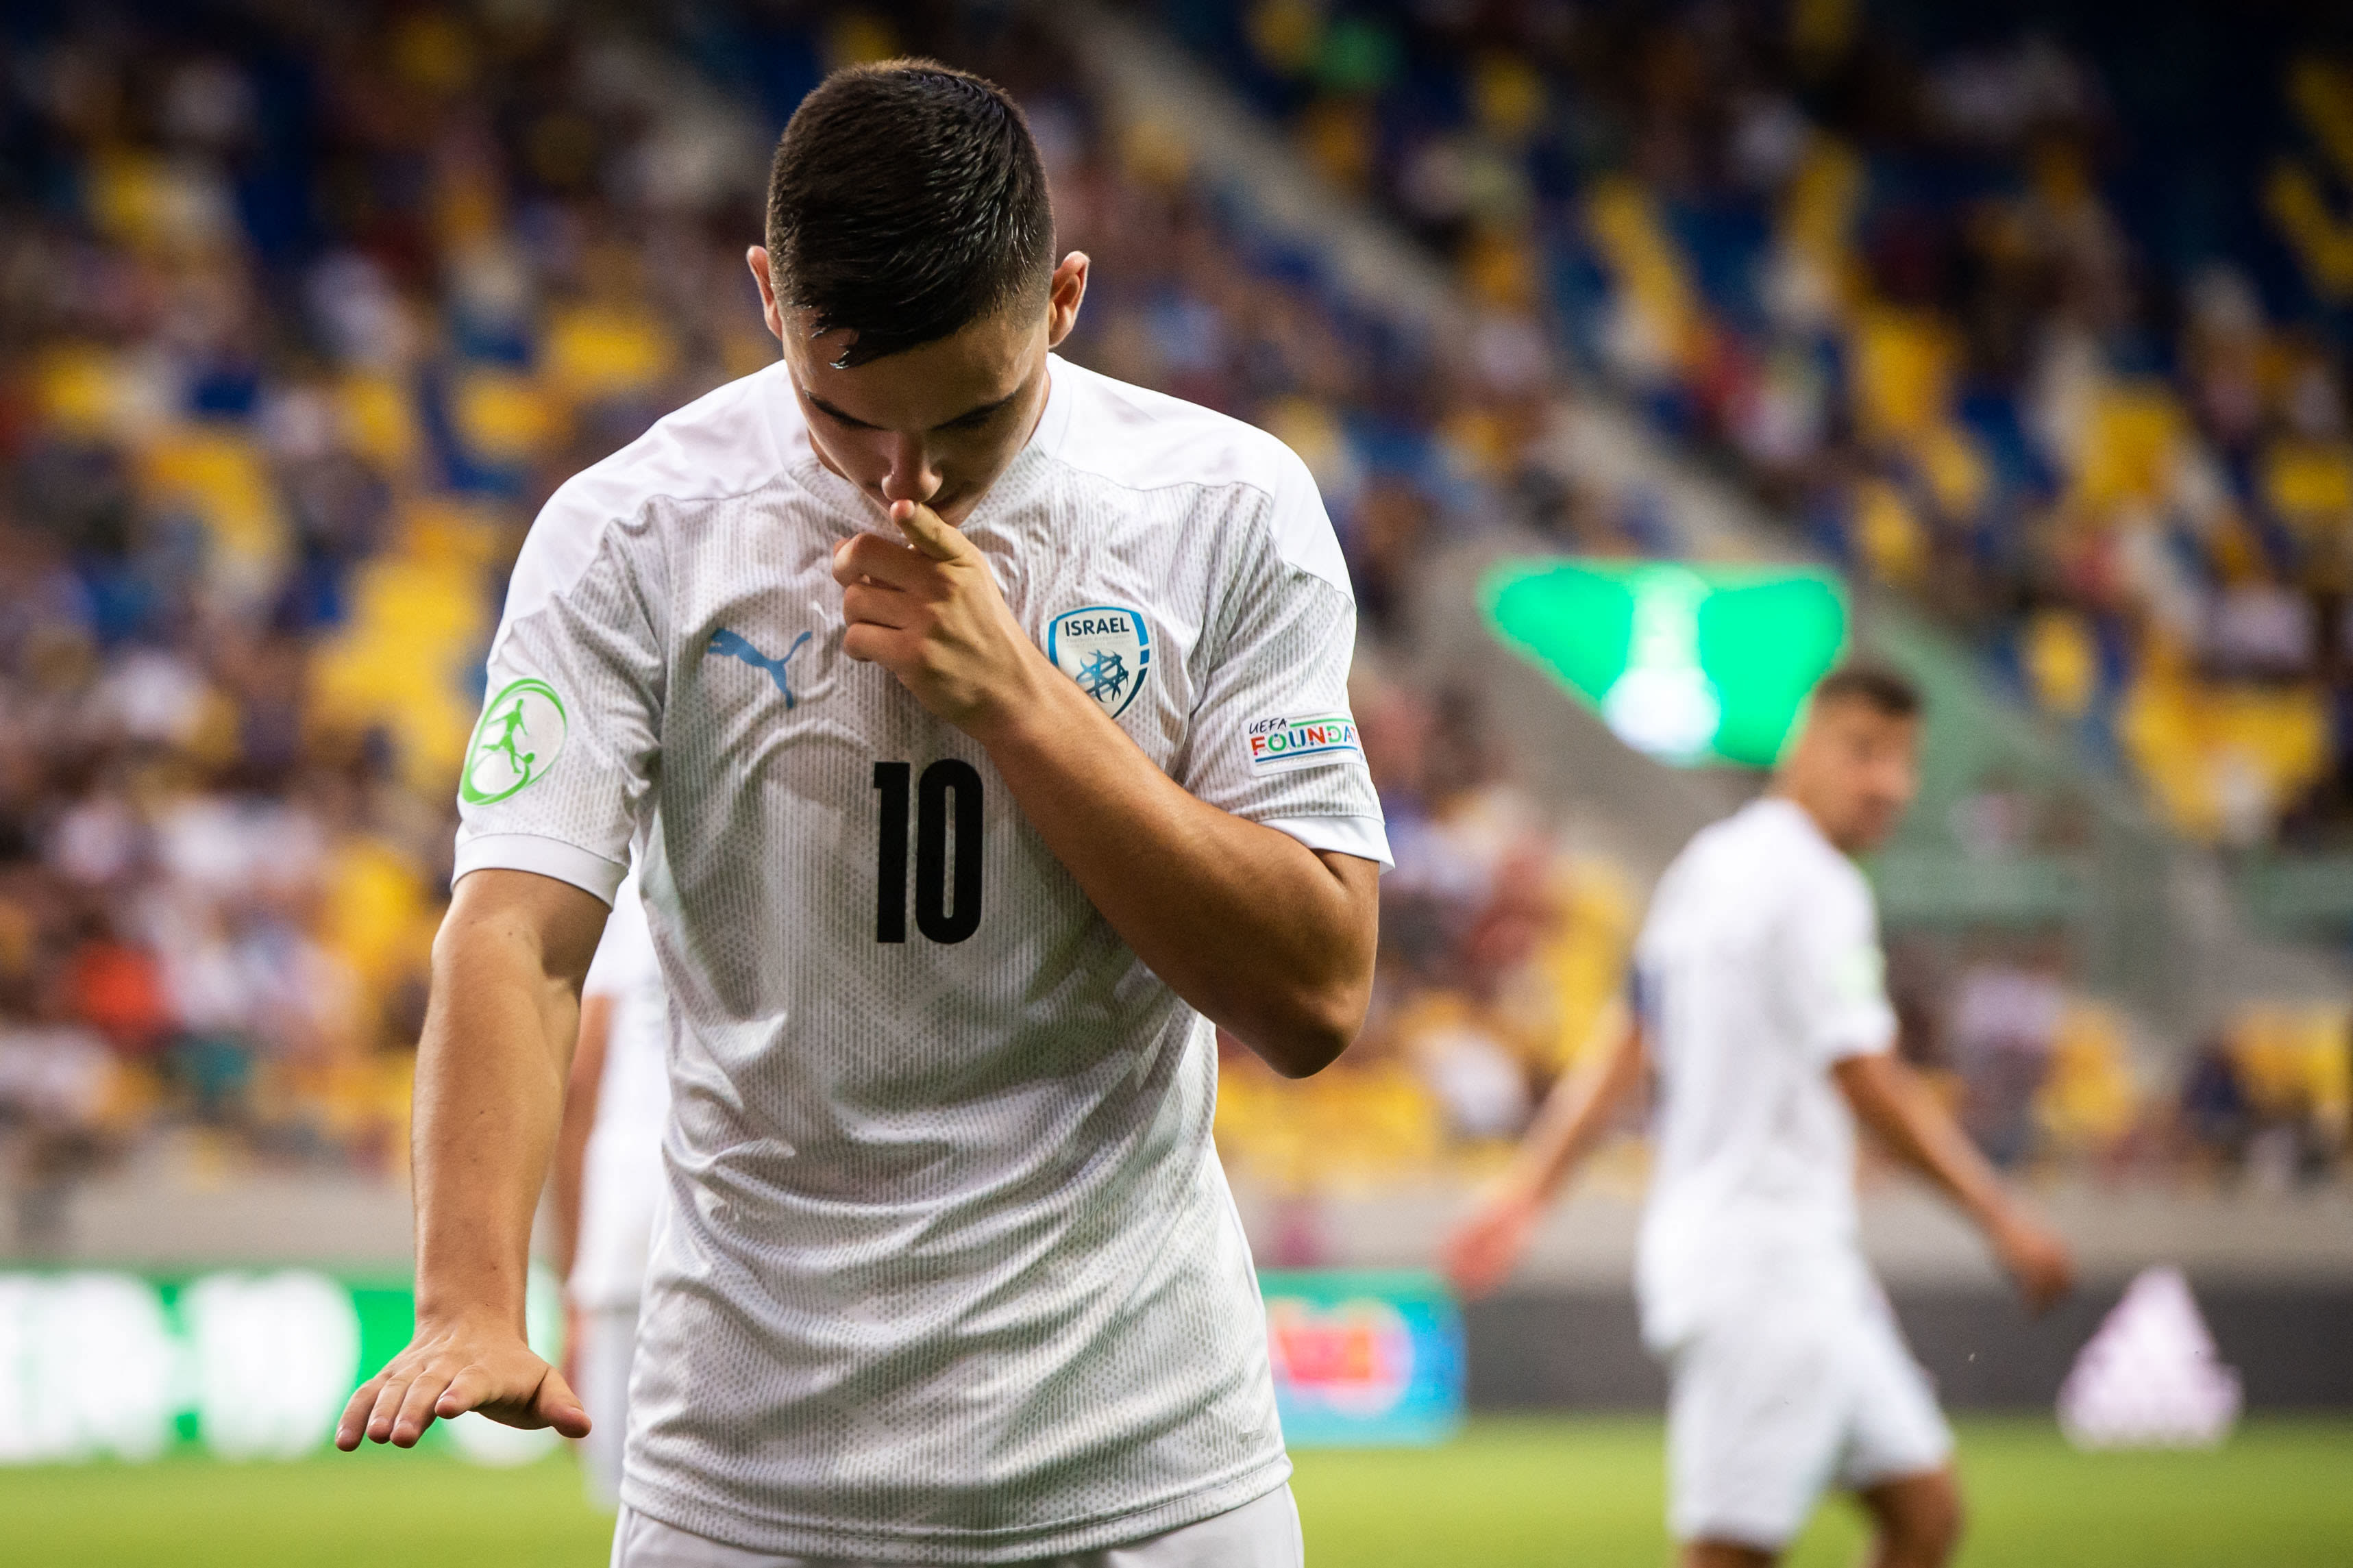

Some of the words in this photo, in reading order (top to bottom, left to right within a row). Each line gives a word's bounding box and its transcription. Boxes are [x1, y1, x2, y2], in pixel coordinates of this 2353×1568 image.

[1065, 617, 1130, 636] ISRAEL
[1248, 717, 1287, 734] UEFA
[874, 758, 983, 944] 10
